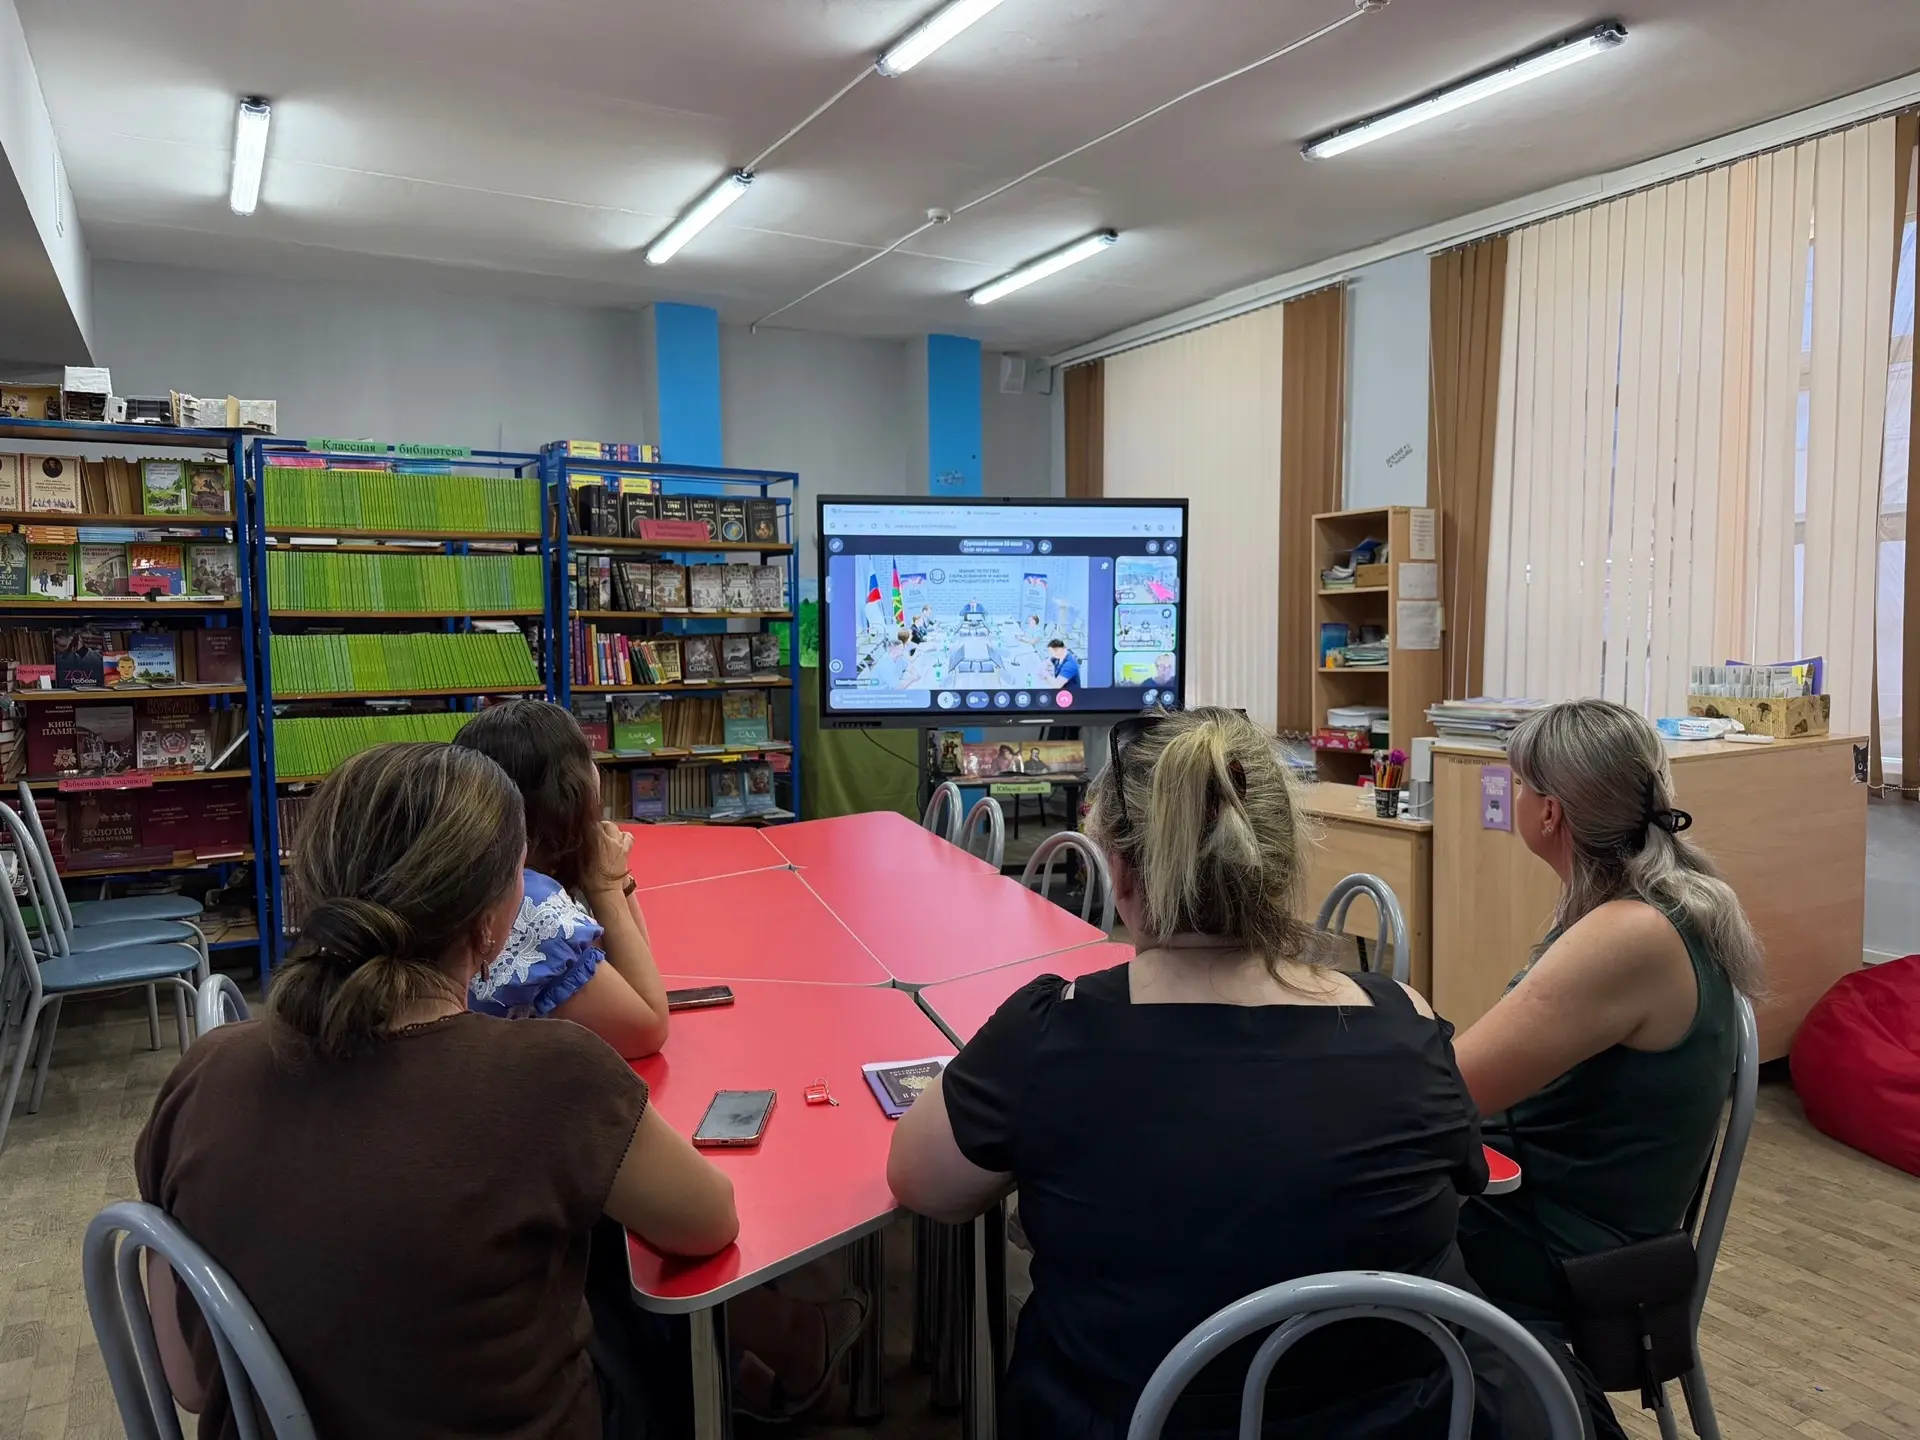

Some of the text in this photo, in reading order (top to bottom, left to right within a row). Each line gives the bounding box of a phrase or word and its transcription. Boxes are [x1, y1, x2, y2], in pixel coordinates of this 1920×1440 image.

[322, 439, 463, 457] Классная библиотека
[63, 670, 93, 681] ZOV
[42, 728, 77, 736] ПАМЯТ
[64, 780, 101, 788] Забвению
[112, 777, 147, 786] подлежит
[82, 827, 133, 838] ЗОЛОТАЯ
